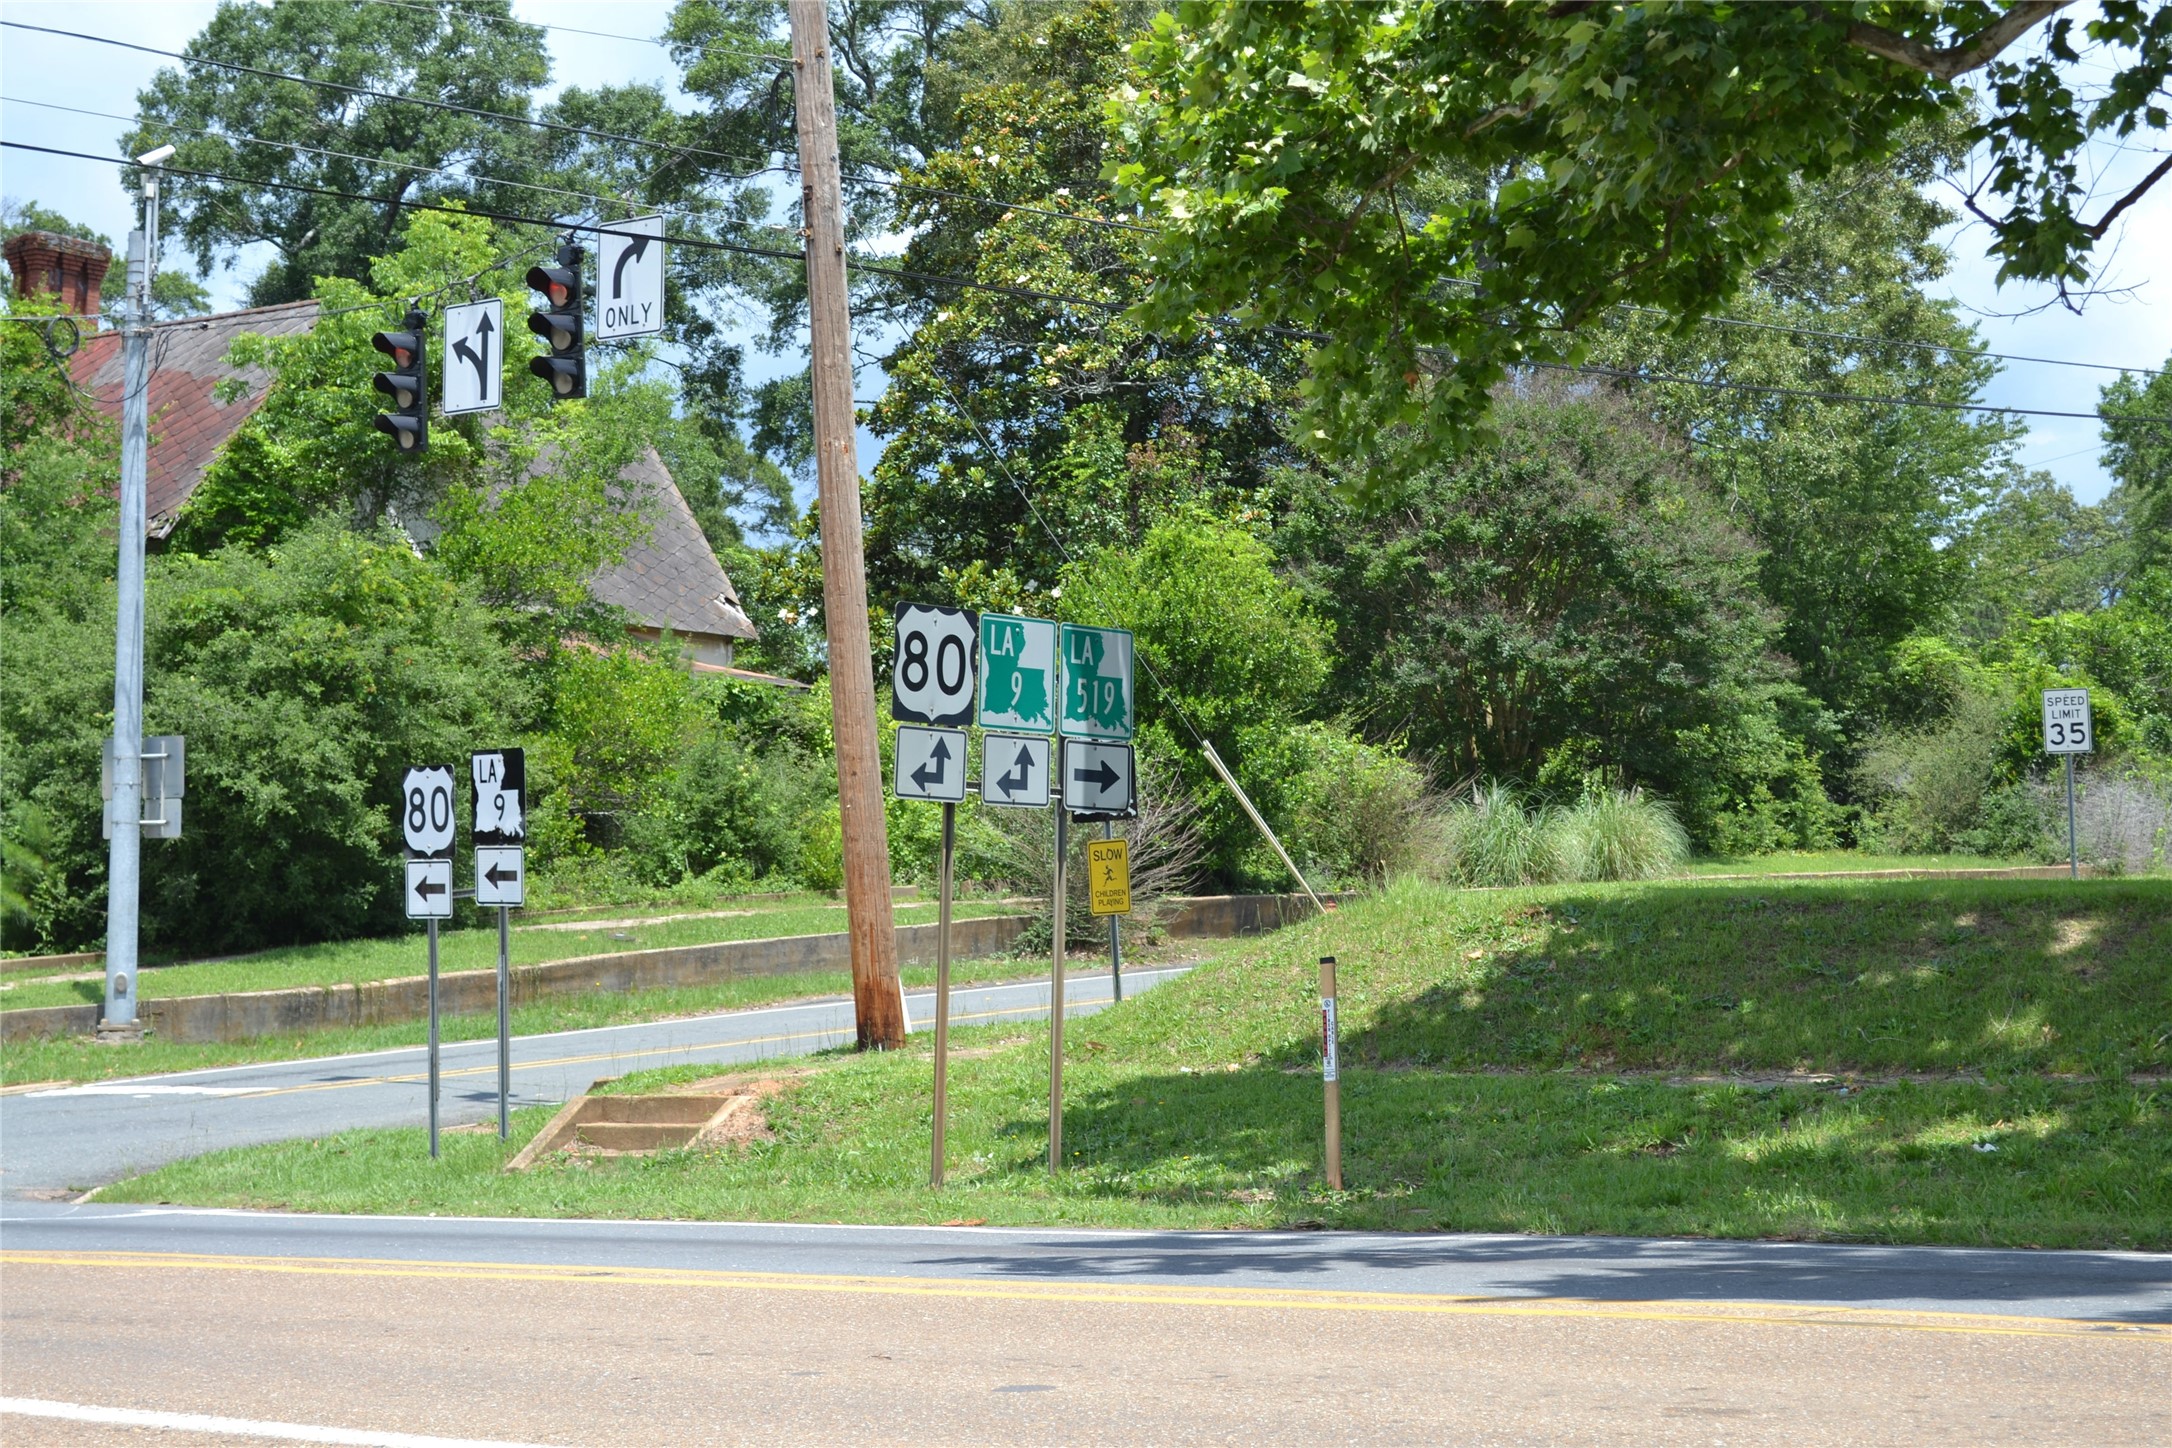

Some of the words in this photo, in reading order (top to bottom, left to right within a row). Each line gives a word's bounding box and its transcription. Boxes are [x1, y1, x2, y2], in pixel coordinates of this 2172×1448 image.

[605, 301, 653, 329] ONLY
[990, 624, 1014, 658] LA
[1070, 633, 1094, 666] LA
[901, 629, 966, 696] 80
[1010, 671, 1023, 705] 9
[1077, 677, 1115, 715] 519
[2047, 696, 2085, 707] SPEED
[2051, 709, 2081, 719] LIMIT
[2050, 722, 2085, 745] 35
[479, 758, 497, 784] LA
[408, 785, 449, 833] 80
[494, 793, 505, 822] 9
[1093, 848, 1123, 862] SLOW
[1095, 889, 1126, 898] CHILDREN
[1098, 898, 1124, 907] PLAYING
